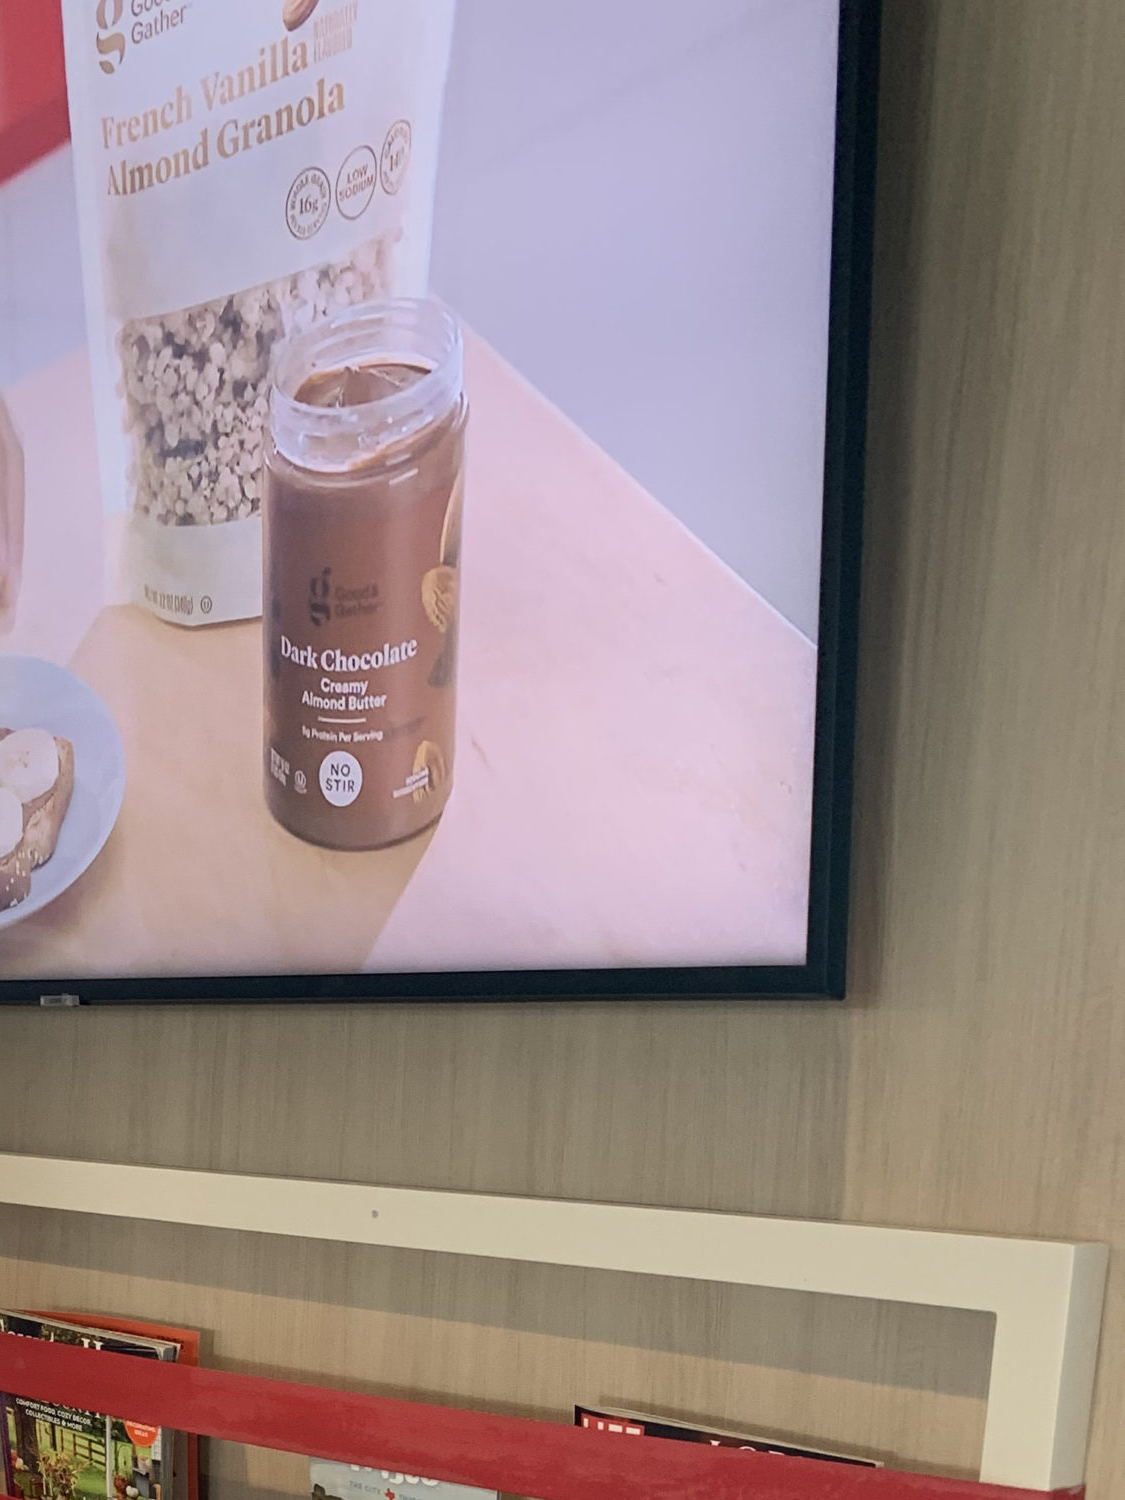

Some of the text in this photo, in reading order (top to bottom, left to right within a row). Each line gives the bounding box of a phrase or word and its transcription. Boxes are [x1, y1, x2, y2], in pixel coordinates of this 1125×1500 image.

[131, 5, 187, 44] Gather
[101, 36, 308, 149] French Vanilla
[107, 77, 346, 196] Almond Granola
[347, 164, 368, 184] LOW
[339, 175, 374, 201] SODIUM
[281, 635, 418, 672] Dark Chocolate
[321, 677, 368, 695] Creamy
[302, 690, 387, 711] Almond Butter
[330, 763, 350, 777] NO
[325, 779, 355, 793] STIR
[16, 1398, 40, 1410] COMFORT
[57, 1410, 72, 1420] COZY
[25, 1409, 61, 1425] COLLECTIBLES
[61, 1420, 67, 1428] &
[67, 1422, 83, 1432] MORE
